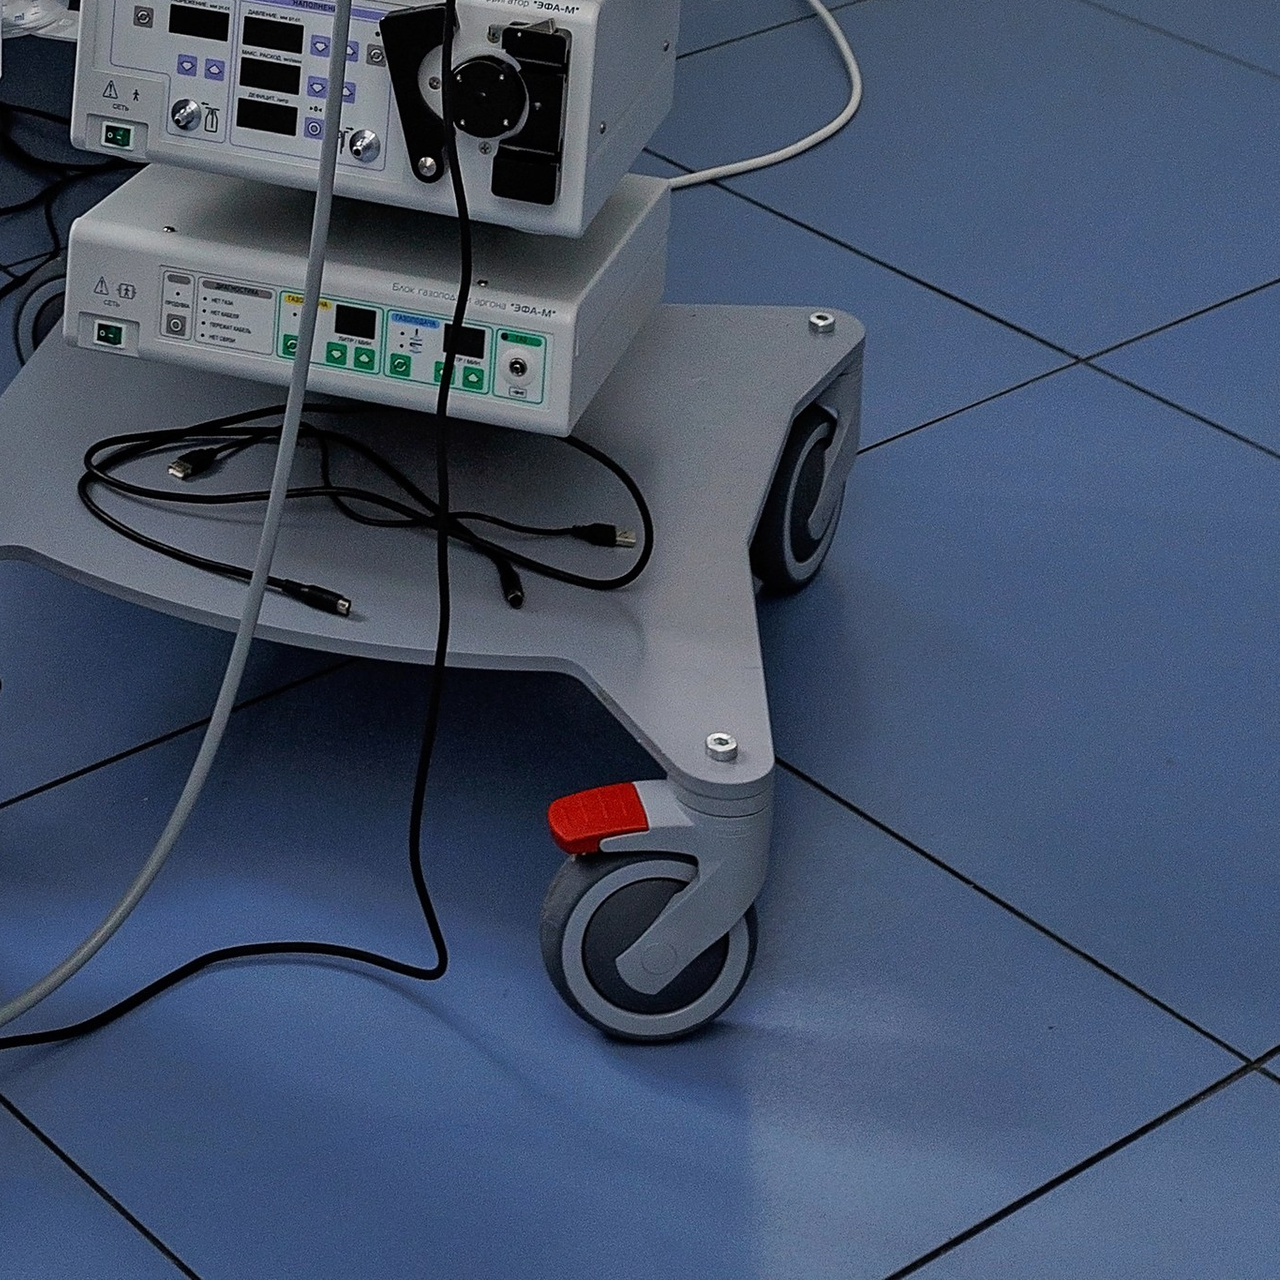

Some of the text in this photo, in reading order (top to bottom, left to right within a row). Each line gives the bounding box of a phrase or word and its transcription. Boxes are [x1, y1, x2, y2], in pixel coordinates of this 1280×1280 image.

[112, 103, 130, 112] СЕТЬ
[392, 282, 414, 294] Блок
[475, 298, 507, 310] аргона
[103, 299, 121, 308] СЕТЬ
